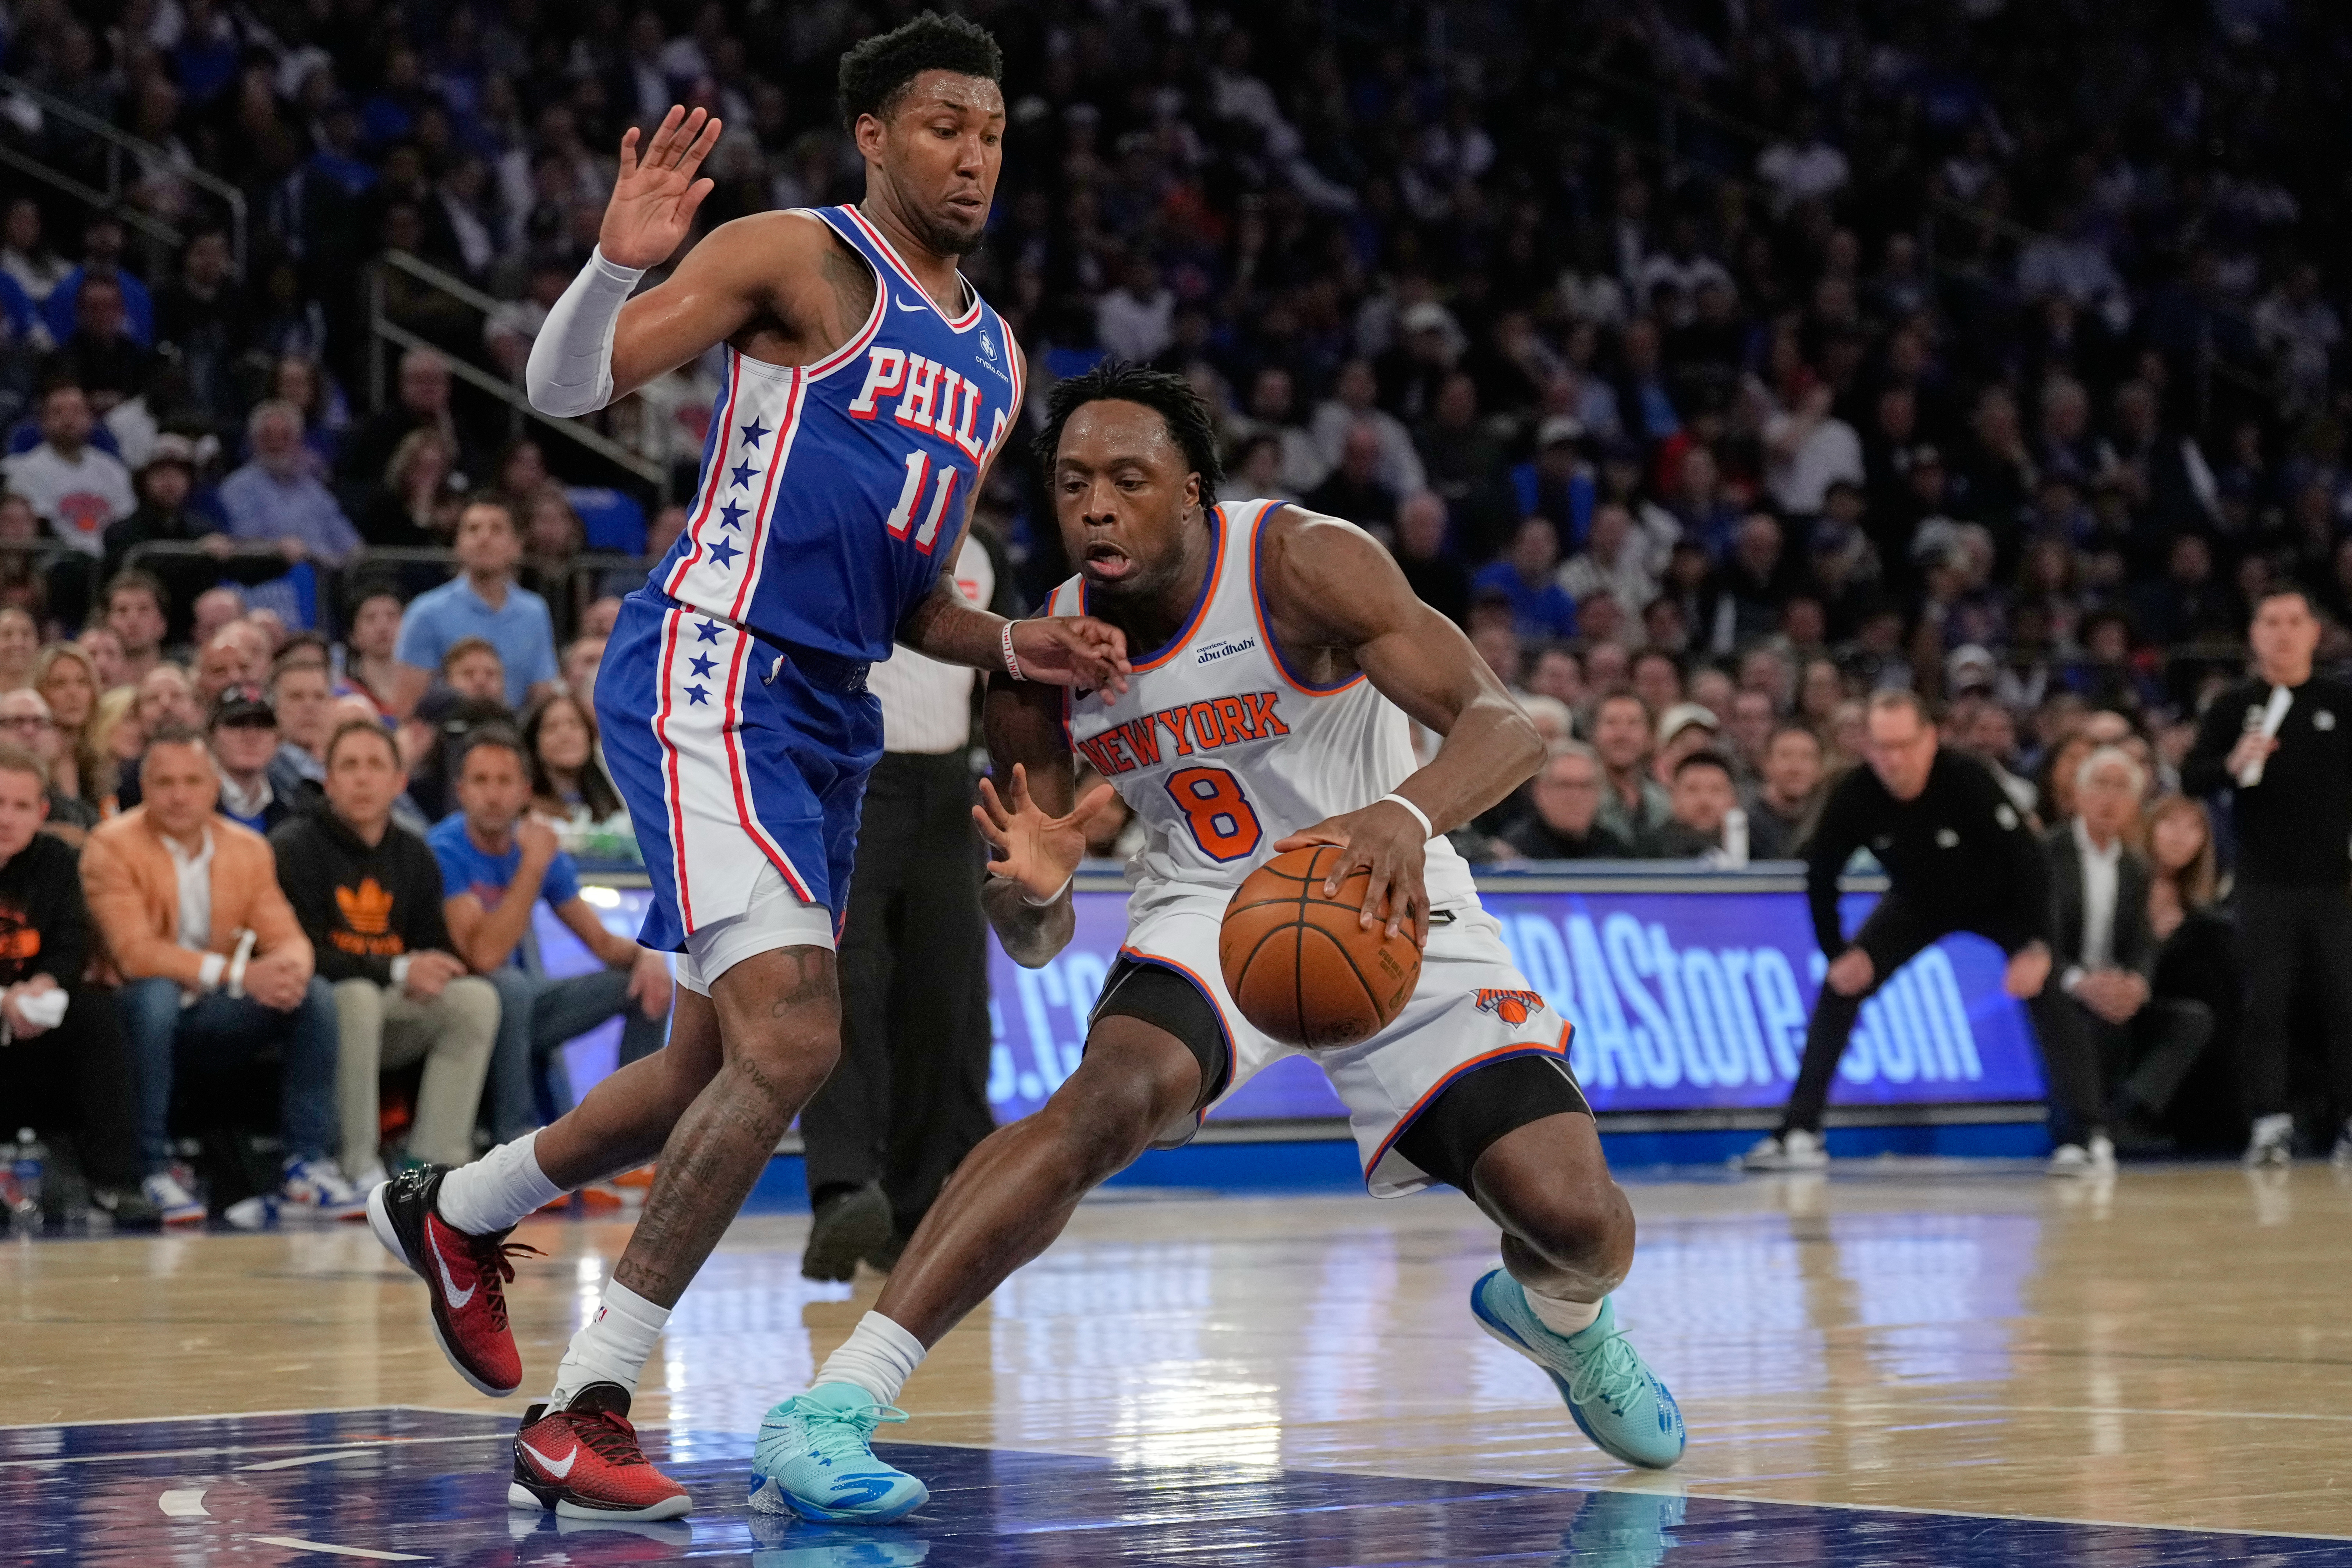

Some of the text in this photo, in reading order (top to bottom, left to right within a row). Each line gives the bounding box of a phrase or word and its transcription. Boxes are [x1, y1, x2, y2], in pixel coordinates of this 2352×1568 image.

[976, 356, 1009, 383] crypto.com
[887, 449, 957, 556] 11
[1197, 640, 1227, 653] experience
[1198, 637, 1255, 663] abu dhabi
[1076, 692, 1291, 776] NEW YORK
[1164, 766, 1263, 863] 8
